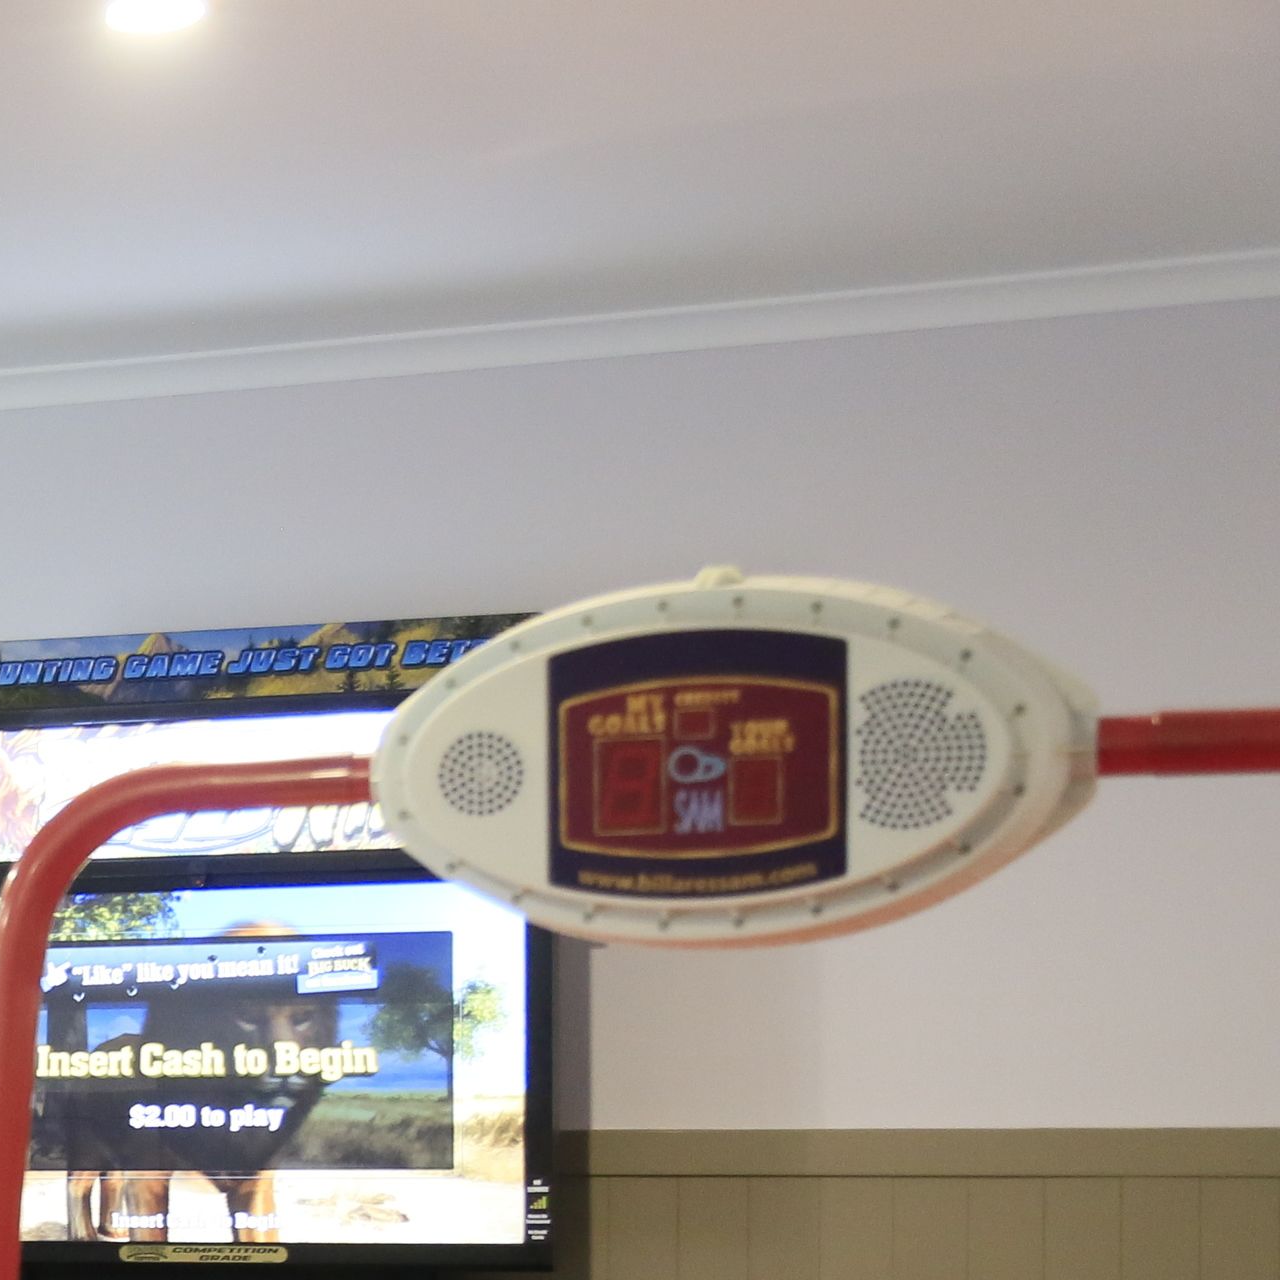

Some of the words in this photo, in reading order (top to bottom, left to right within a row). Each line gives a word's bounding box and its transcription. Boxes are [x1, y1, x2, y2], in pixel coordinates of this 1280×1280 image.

[124, 651, 224, 678] GAME
[227, 646, 319, 674] JUST
[325, 643, 396, 669] GOT
[401, 638, 486, 666] BET
[674, 788, 724, 836] SAM
[136, 961, 175, 983] like
[177, 960, 215, 985] you
[218, 956, 274, 979] mean
[278, 953, 300, 975] it!
[36, 1044, 135, 1079] Insert
[139, 1042, 226, 1079] Cash
[233, 1043, 268, 1077] to
[274, 1039, 379, 1083] Begin
[128, 1103, 197, 1130] $2.00
[200, 1105, 226, 1128] to
[228, 1103, 287, 1132] play
[172, 1246, 279, 1254] COMPETITION
[199, 1254, 252, 1262] GRADE
